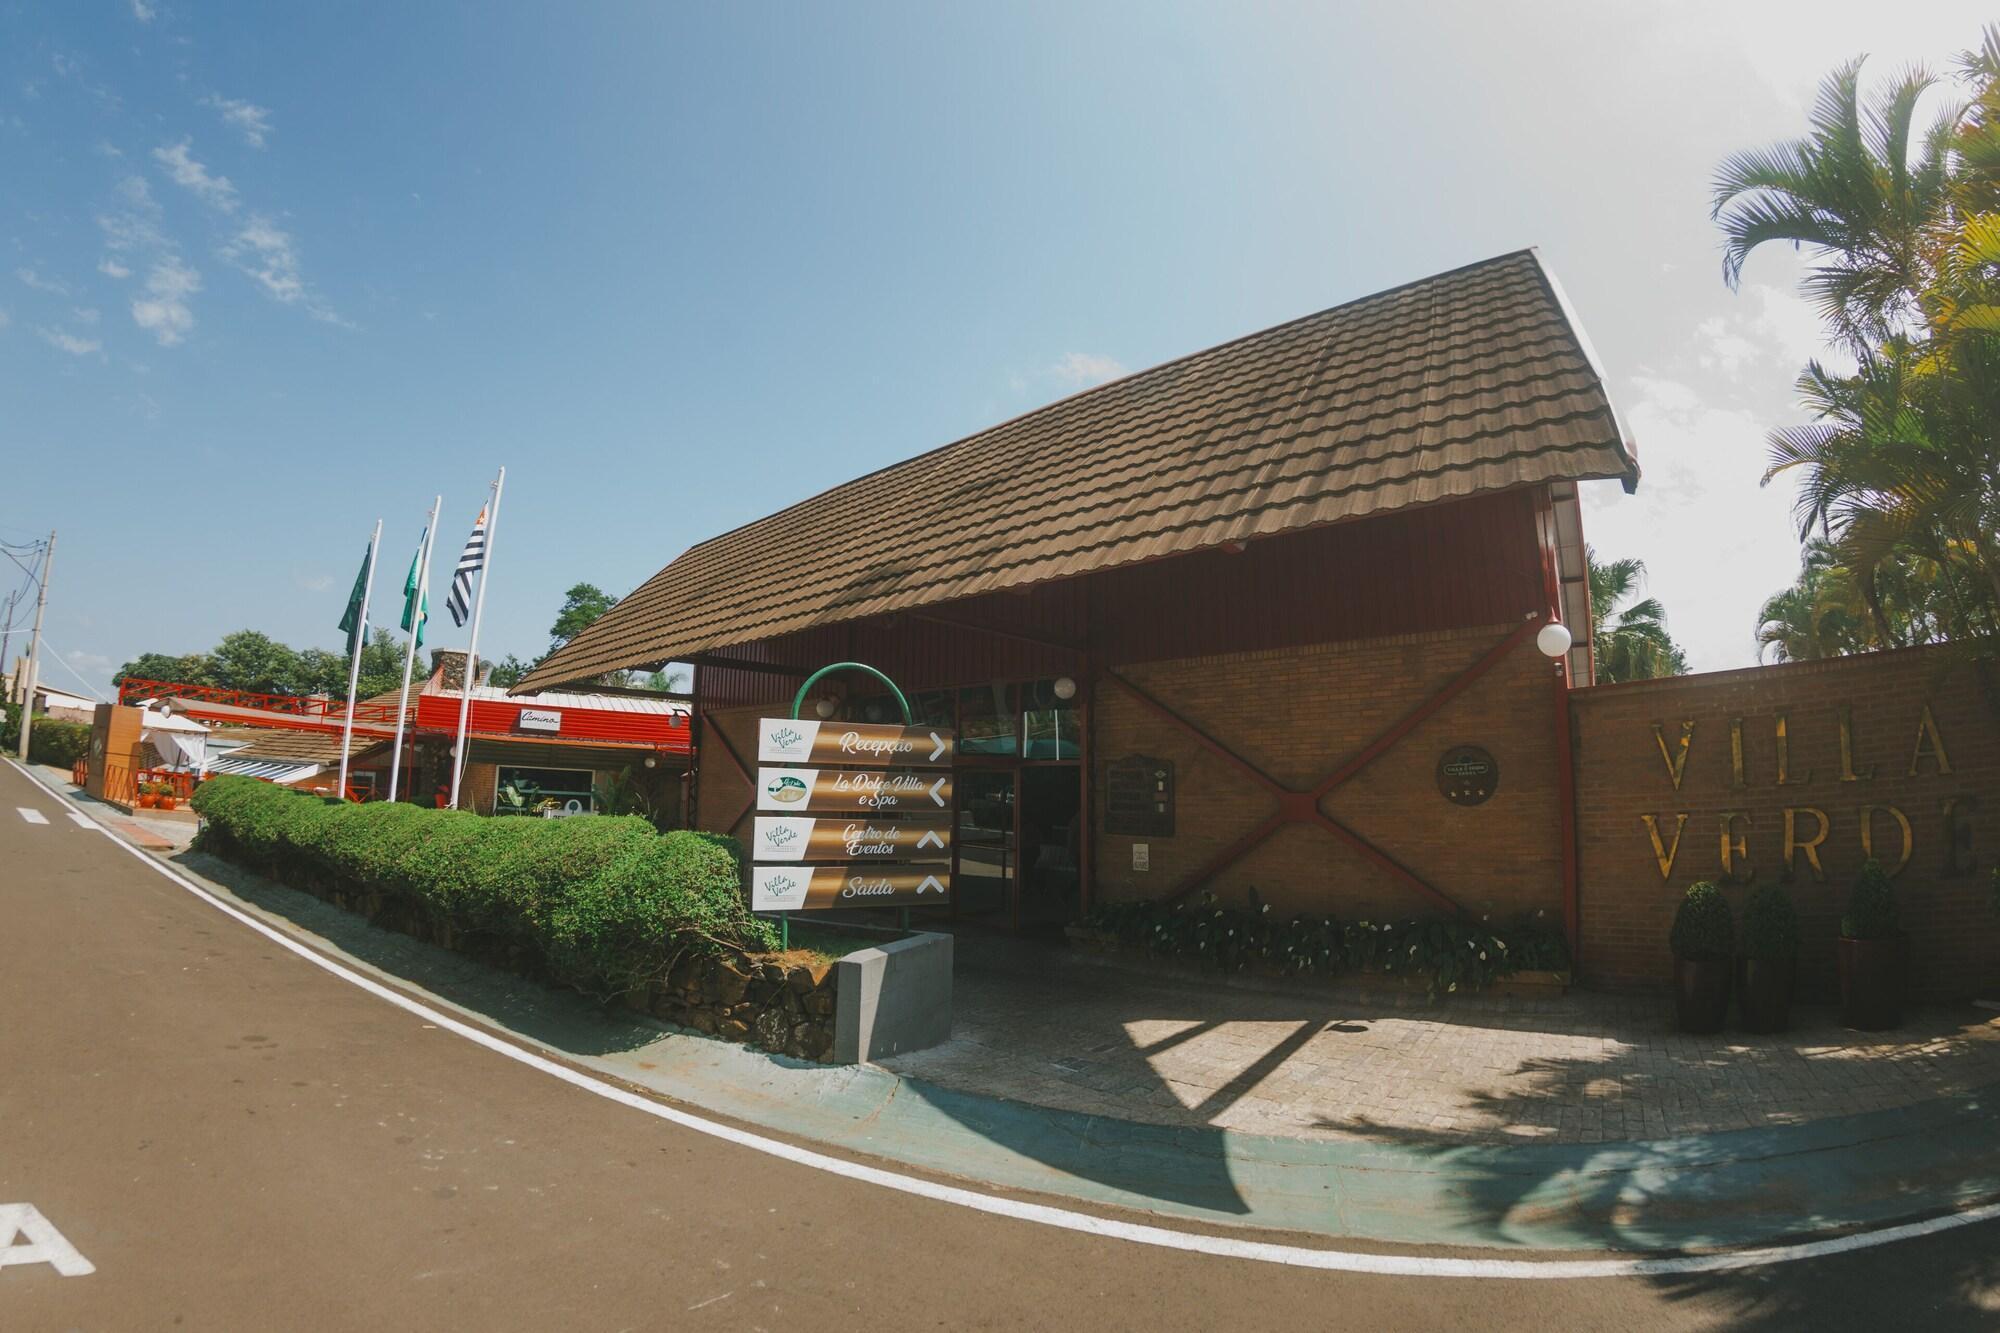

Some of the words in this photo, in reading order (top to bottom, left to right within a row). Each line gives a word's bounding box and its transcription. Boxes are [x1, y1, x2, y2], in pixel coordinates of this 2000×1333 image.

[771, 728, 794, 743] Villa
[779, 733, 802, 748] Verde
[839, 731, 912, 756] Recepção
[1650, 703, 1953, 791] VILLA
[832, 774, 849, 792] La
[852, 773, 890, 792] Dolce
[892, 776, 925, 792] Villa
[858, 795, 867, 805] e
[868, 790, 898, 809] Spa
[766, 825, 789, 842] Villa
[774, 830, 797, 847] Verde
[843, 823, 882, 841] Centro
[884, 825, 901, 840] de
[1639, 795, 1978, 885] VERDE
[846, 839, 895, 856] Eventos
[765, 875, 788, 891] Villa
[773, 880, 796, 896] Verde
[842, 876, 896, 898] Saída
